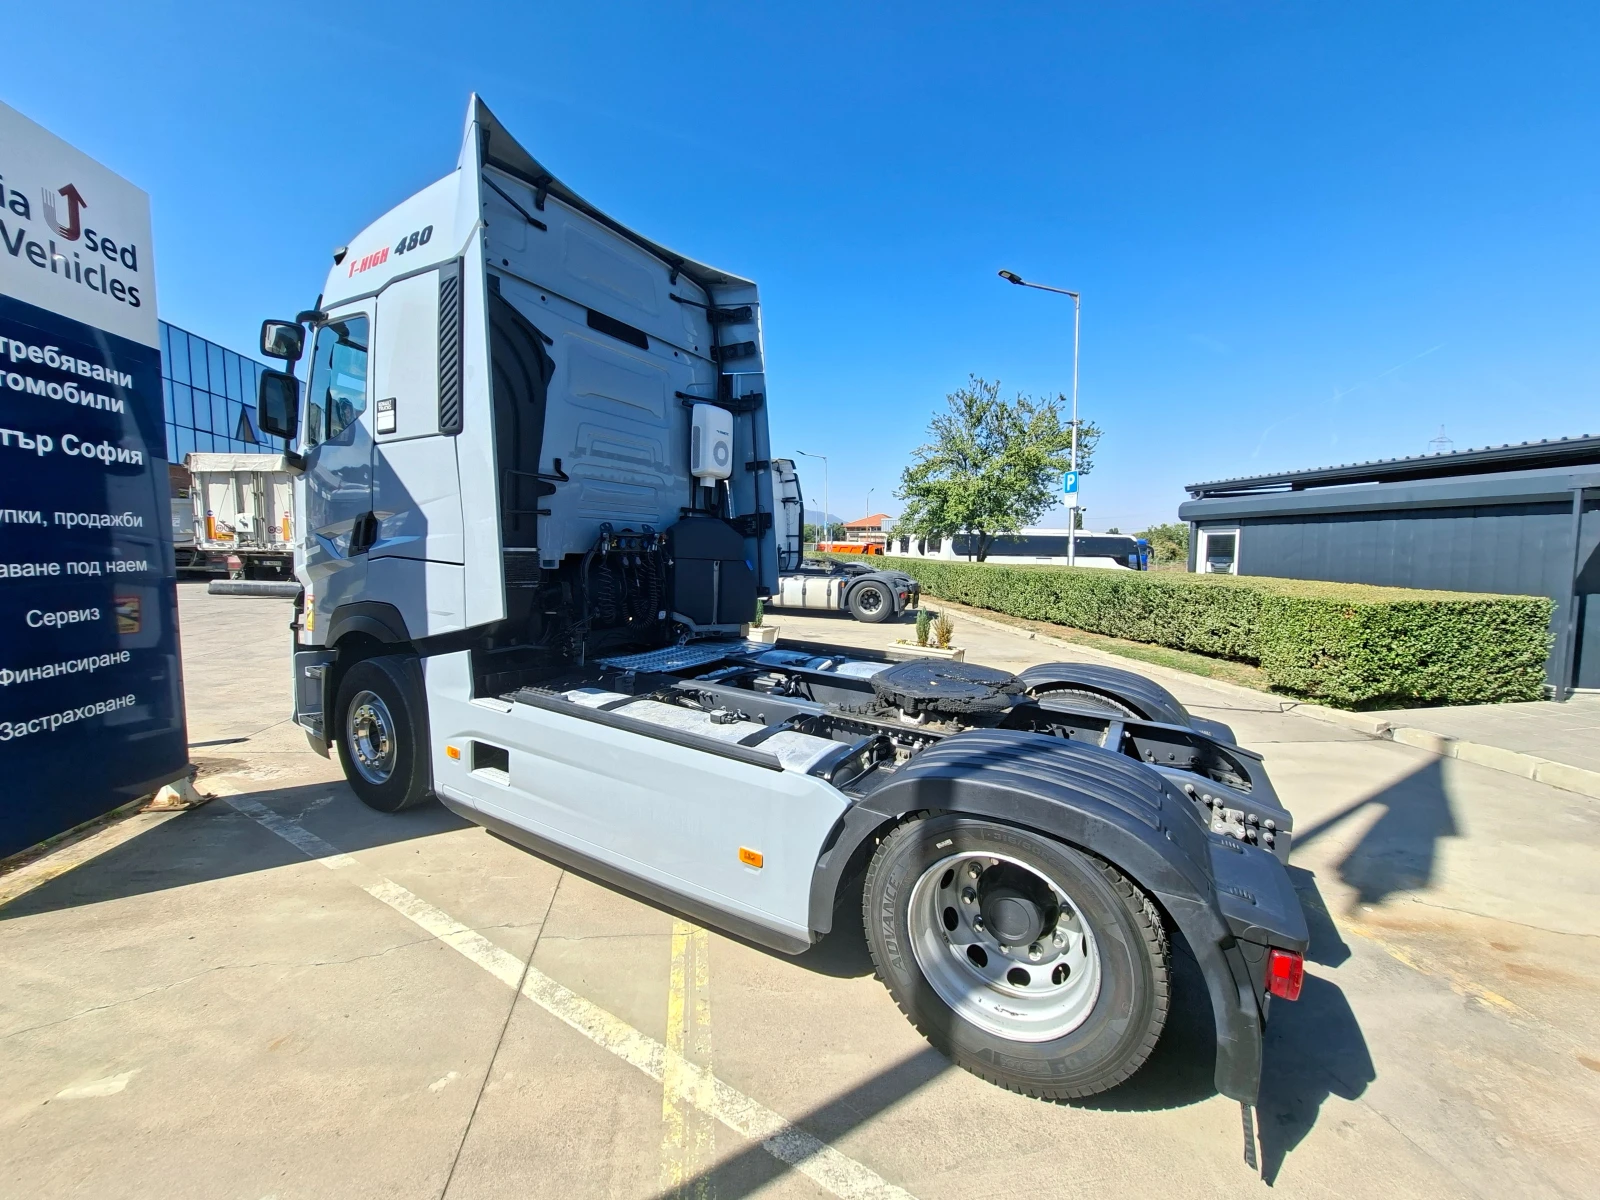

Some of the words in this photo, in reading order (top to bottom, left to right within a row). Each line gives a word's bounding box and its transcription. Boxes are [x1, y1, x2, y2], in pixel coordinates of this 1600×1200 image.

[0, 219, 141, 308] Vehicles
[348, 247, 390, 278] T-HIGH
[394, 225, 434, 256] 480
[61, 433, 143, 465] София
[1067, 474, 1076, 491] P
[54, 511, 143, 529] продажби
[0, 562, 61, 578] аване
[67, 561, 101, 576] под
[106, 560, 148, 573] наем
[26, 607, 101, 628] Сервиз
[0, 650, 131, 687] Финансиране
[0, 693, 136, 741] Застраховане
[882, 875, 906, 973] ADVANCE
